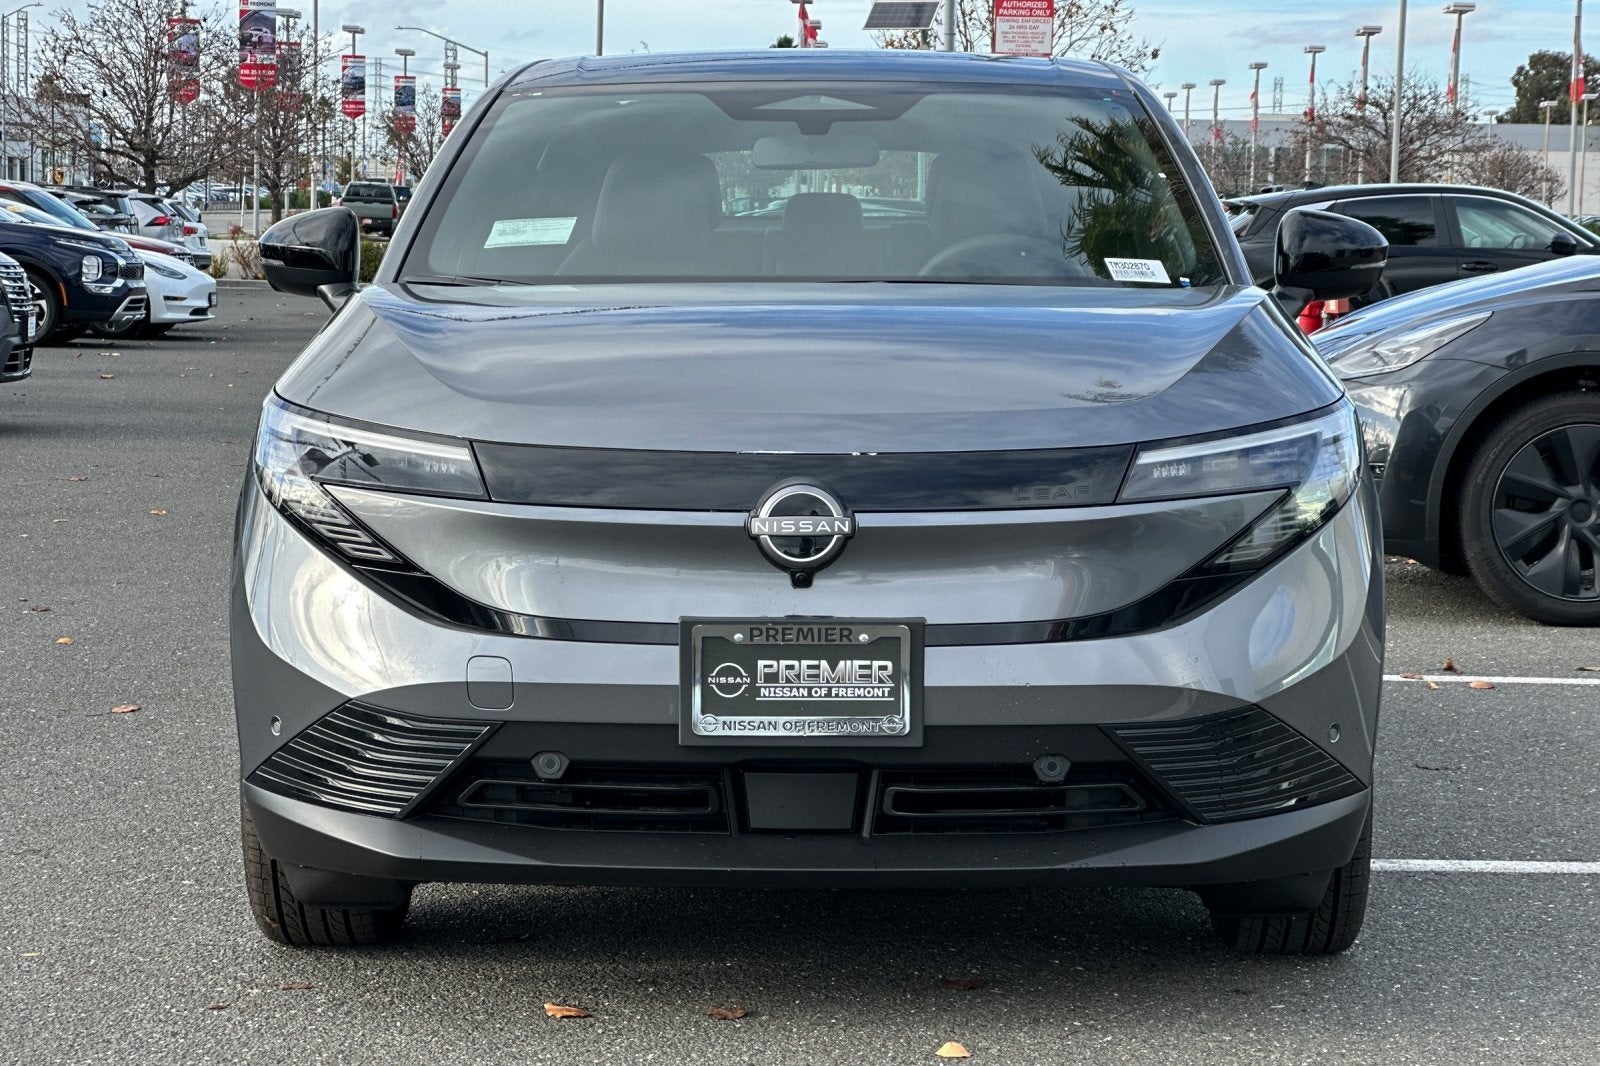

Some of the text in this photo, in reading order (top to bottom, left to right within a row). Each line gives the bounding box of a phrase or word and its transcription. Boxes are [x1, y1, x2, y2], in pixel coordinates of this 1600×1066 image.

[1012, 485, 1090, 501] LEAF
[754, 520, 849, 533] NISSAN
[749, 626, 853, 643] PREMIER
[757, 659, 893, 684] PREMIER
[707, 676, 750, 684] NISSAN
[760, 687, 891, 697] NISSAN OF FREMONT
[722, 720, 778, 731] NISSAN
[782, 720, 803, 732] OF
[807, 720, 881, 732] FREMONT
